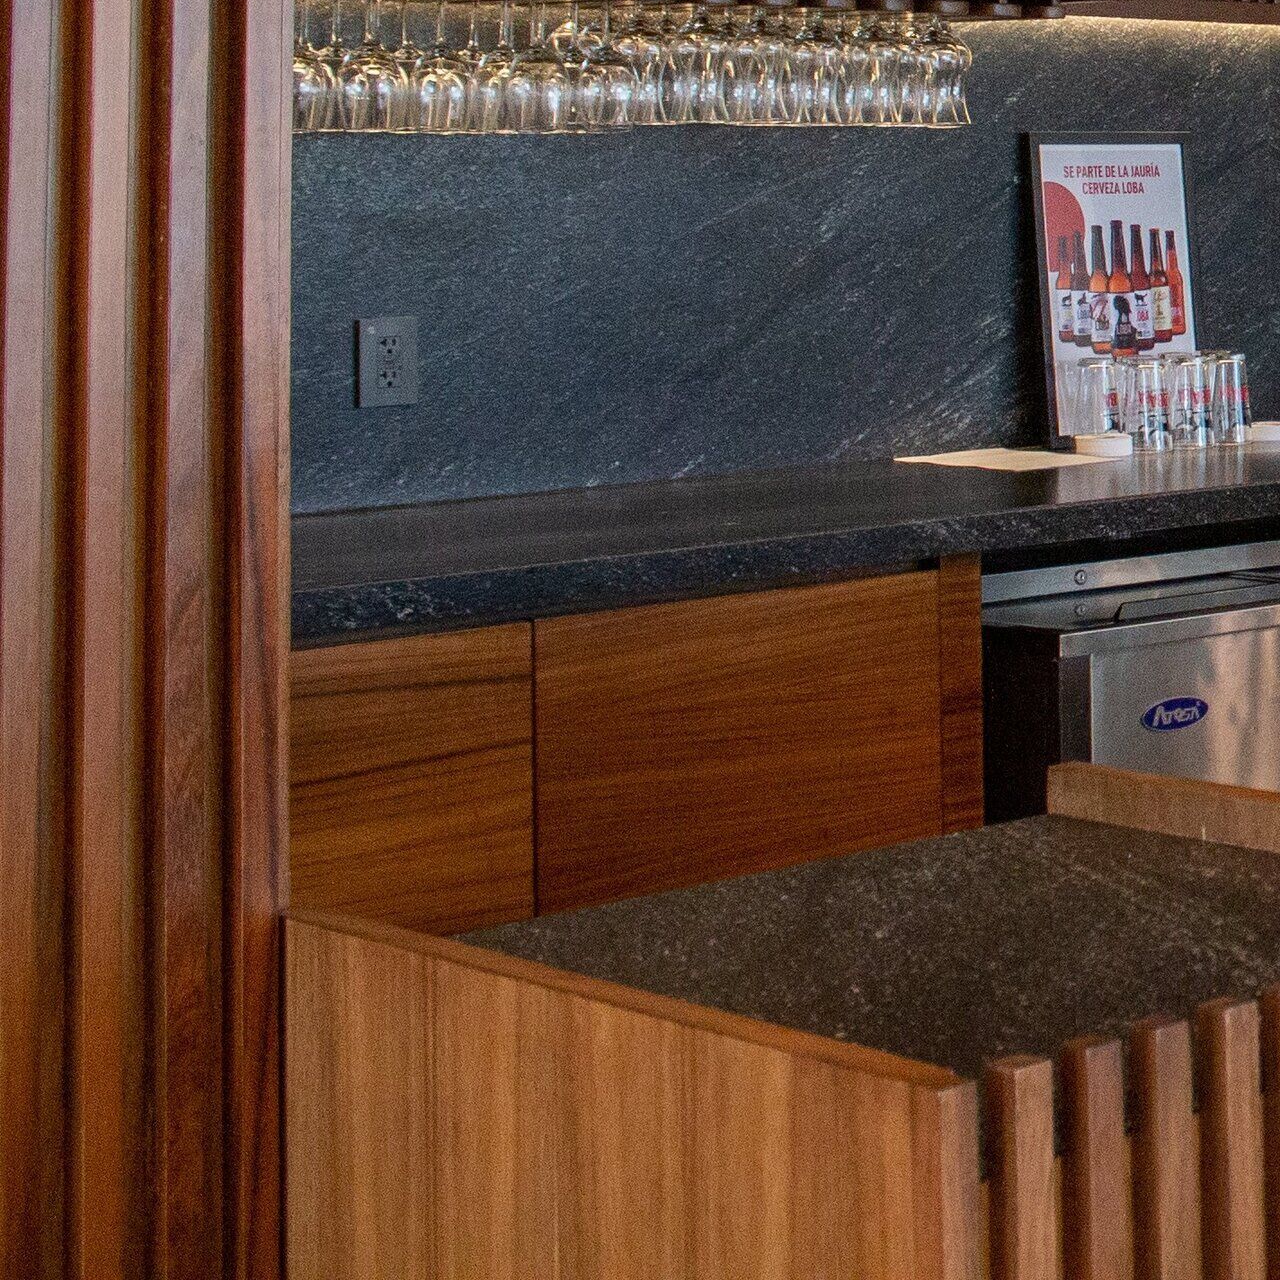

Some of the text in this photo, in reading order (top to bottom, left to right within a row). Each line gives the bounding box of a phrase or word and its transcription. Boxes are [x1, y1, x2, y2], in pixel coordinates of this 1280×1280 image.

[1063, 162, 1160, 178] SE PARTE DE LA JAURÍA
[1082, 181, 1145, 194] CERVEZA LOBA
